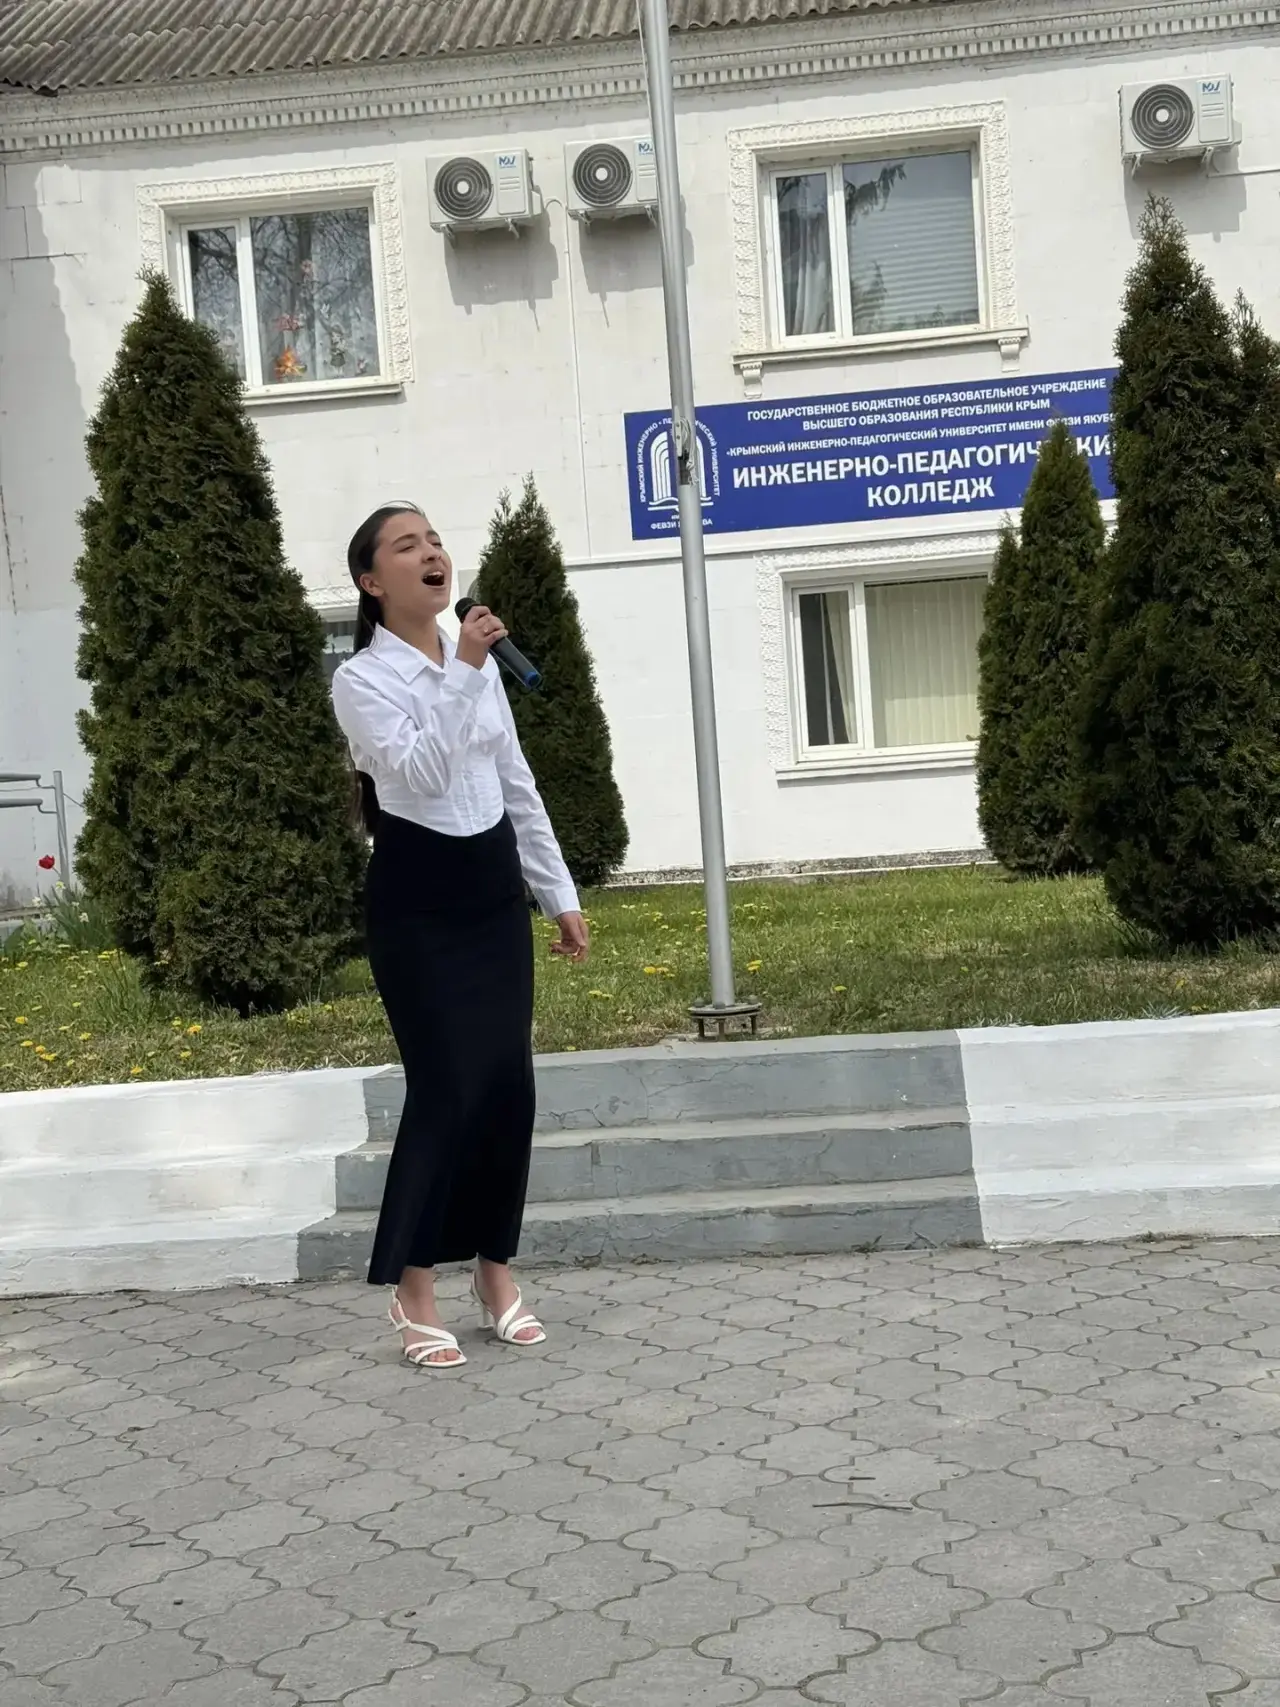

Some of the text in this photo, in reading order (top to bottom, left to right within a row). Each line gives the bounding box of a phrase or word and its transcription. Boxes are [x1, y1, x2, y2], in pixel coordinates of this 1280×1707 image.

[747, 378, 1107, 421] ГОСУДАРСТВЕННОЕ БЮДЖЕТНОЕ ОБРАЗОВАТЕЛЬНОЕ УЧРЕЖДЕНИЕ
[802, 398, 1050, 431] ВЫСШЕГО ОБРАЗОВАНИЯ РЕСПУБЛИКИ КРЫМ
[637, 422, 658, 463] ИНЖЕНЕРНО
[787, 427, 938, 452] ИНЖЕНЕРНО-ПЕДАГОГИЧЕСКИЙ
[939, 423, 1007, 438] УНИВЕРСИТЕТ
[1008, 419, 1044, 432] ИМЕНИ
[636, 464, 647, 503] КРЫМСКИЙ
[867, 475, 995, 508] КОЛЛЕДЖ
